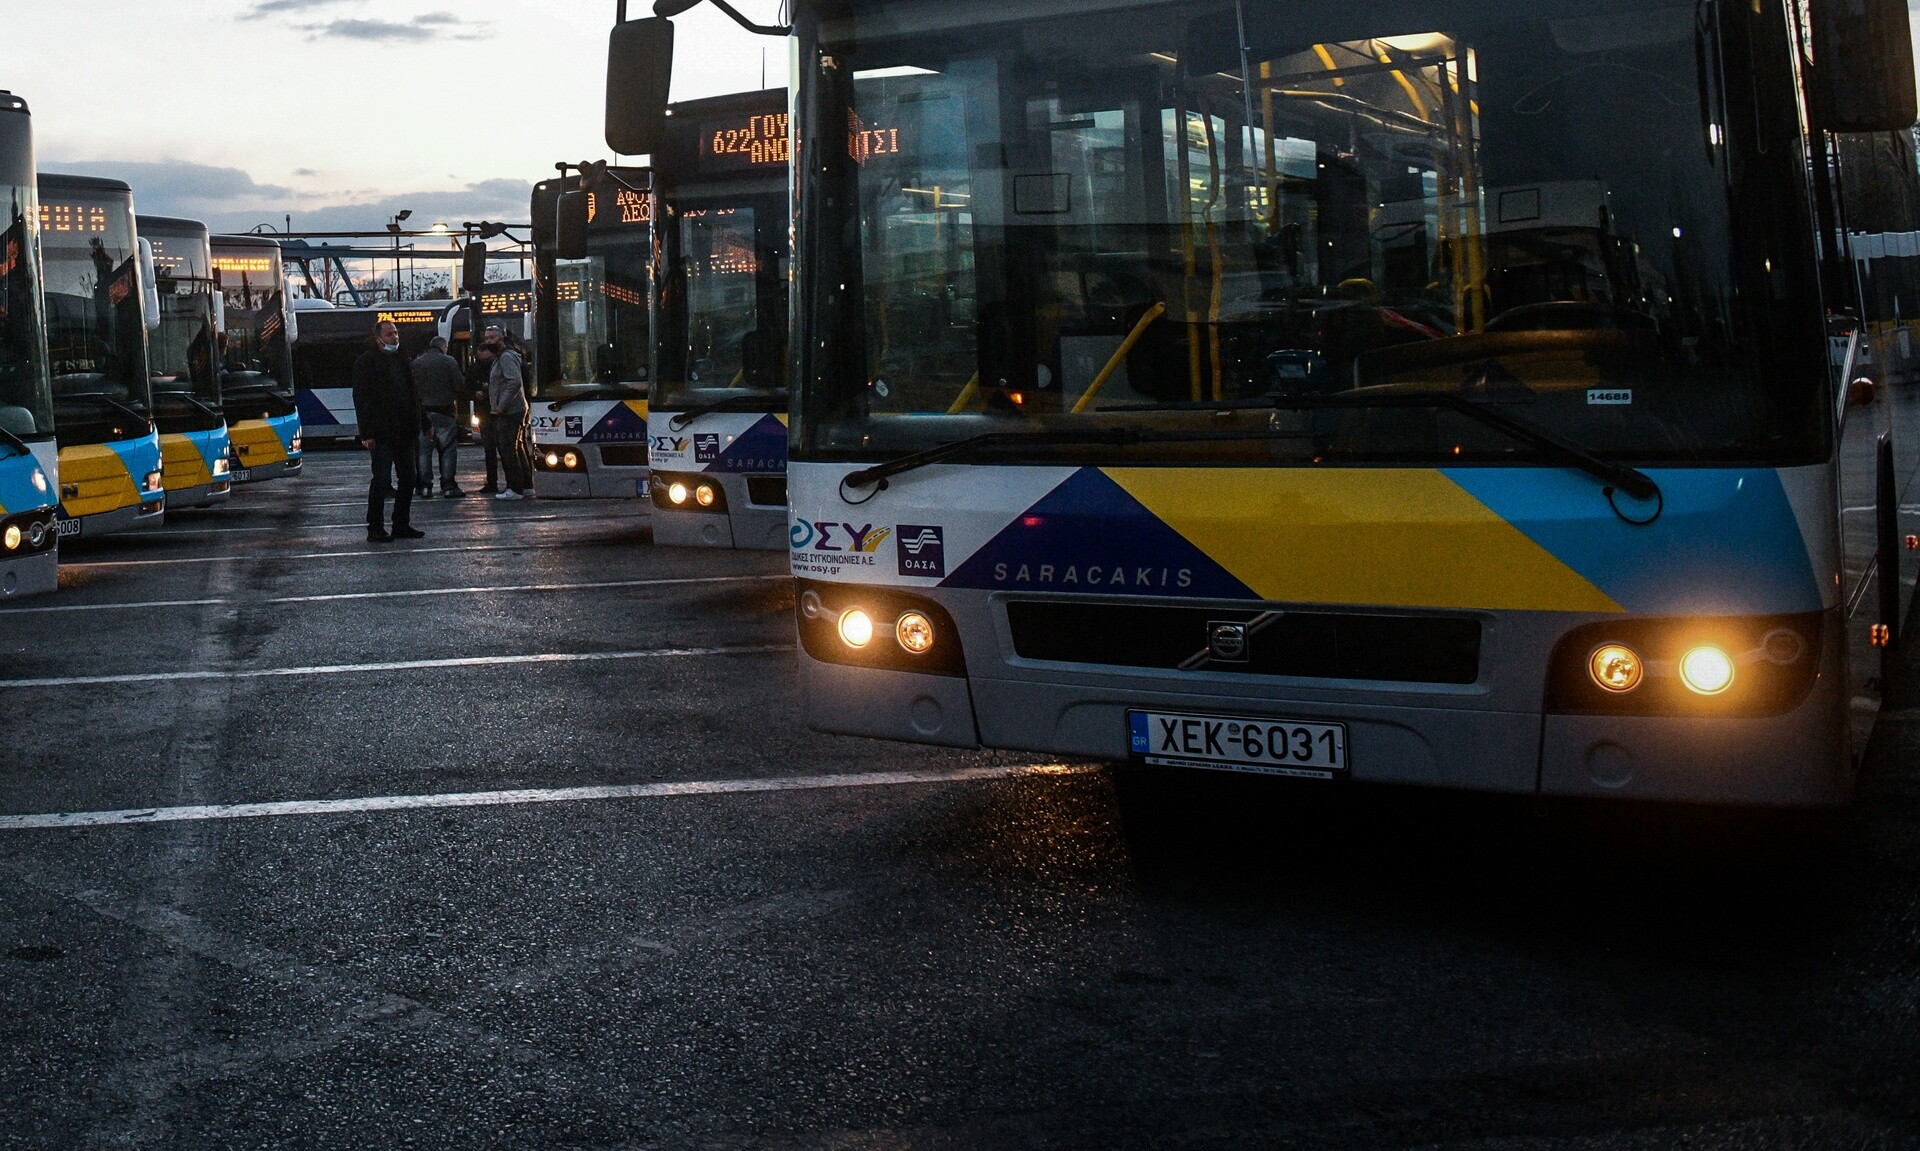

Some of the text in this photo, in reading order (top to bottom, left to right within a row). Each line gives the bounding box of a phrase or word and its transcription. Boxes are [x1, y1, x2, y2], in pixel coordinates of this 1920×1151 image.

[713, 128, 750, 154] 622
[750, 138, 789, 163] ΑΝΩ
[1589, 392, 1630, 401] 14688
[809, 553, 861, 565] ΣΥΓΚΟΙΝΩΝΙΕΣ
[861, 555, 876, 566] Α.Ε.
[904, 559, 937, 570] ΟΑΣΑ
[792, 563, 841, 576] www.osy.gr
[993, 562, 1193, 588] SARACAKIS
[1132, 736, 1147, 747] GR
[1159, 717, 1337, 765] XEK-6031
